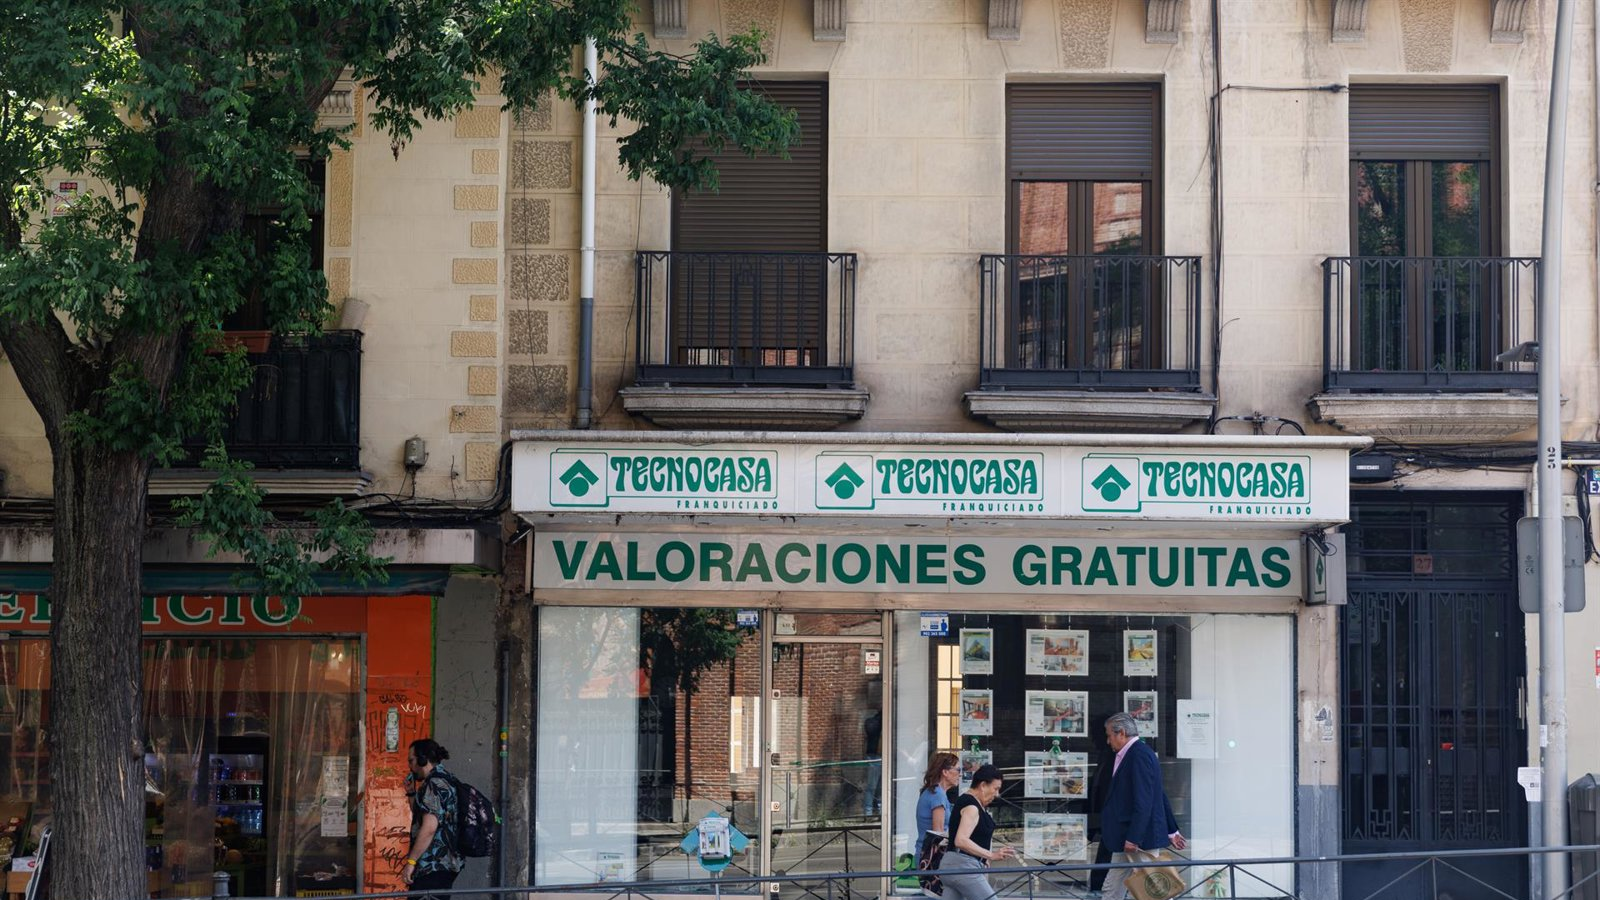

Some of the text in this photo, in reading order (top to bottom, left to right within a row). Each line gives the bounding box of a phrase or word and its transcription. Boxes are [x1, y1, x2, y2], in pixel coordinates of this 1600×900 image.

[610, 456, 772, 493] TECNOCASA
[876, 458, 1038, 495] TECNOCASA
[1142, 461, 1305, 498] TECNOCASA
[677, 500, 778, 510] FRANQUICIADO
[943, 502, 1044, 512] FRANQUICIADO
[1209, 505, 1311, 515] FRANQUICIADO
[552, 540, 1292, 589] VALORACIONES GRATUITAS
[1415, 557, 1432, 570] 27
[0, 594, 303, 627] EICIO
